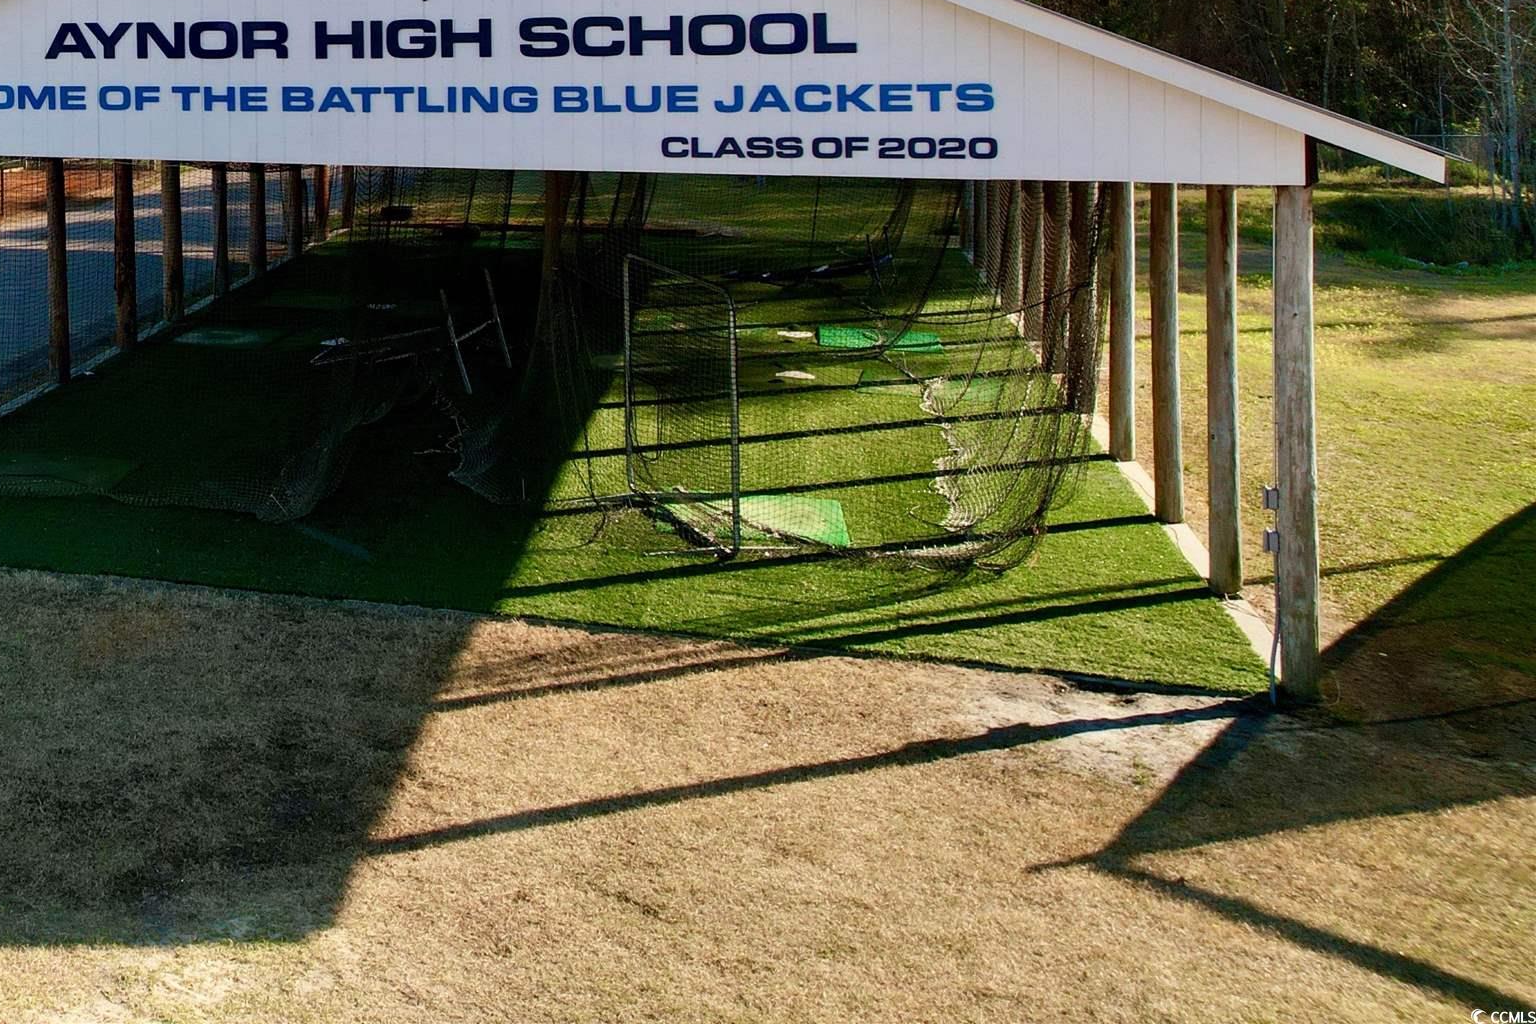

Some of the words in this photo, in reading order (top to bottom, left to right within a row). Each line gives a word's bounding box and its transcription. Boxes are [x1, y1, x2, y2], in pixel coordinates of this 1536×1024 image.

[44, 20, 289, 60] AYNOR
[313, 17, 493, 60] HIGH
[518, 11, 859, 58] SCHOOL
[97, 85, 161, 112] OF
[170, 85, 269, 113] THE
[281, 85, 539, 114] BATTLING
[552, 85, 699, 114] BLUE
[713, 82, 995, 114] JACKETS
[660, 136, 805, 160] CLASS
[811, 136, 870, 160] OF
[877, 136, 999, 160] 2020
